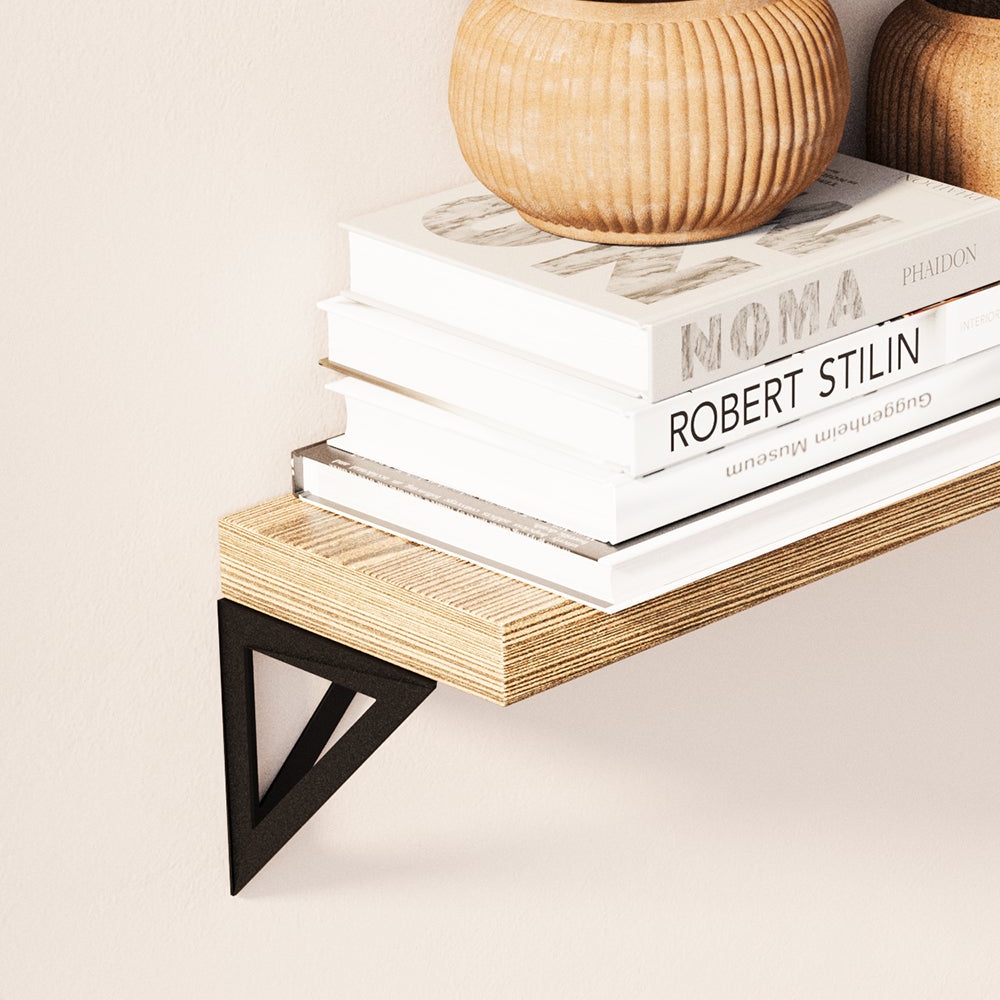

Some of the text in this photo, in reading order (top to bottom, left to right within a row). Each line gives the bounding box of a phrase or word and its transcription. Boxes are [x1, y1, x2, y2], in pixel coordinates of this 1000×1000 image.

[680, 244, 978, 381] NOMA PHAIDON
[670, 368, 804, 452] ROBERT
[819, 328, 921, 398] STILIN
[726, 391, 933, 480] Guggenheim Museum
